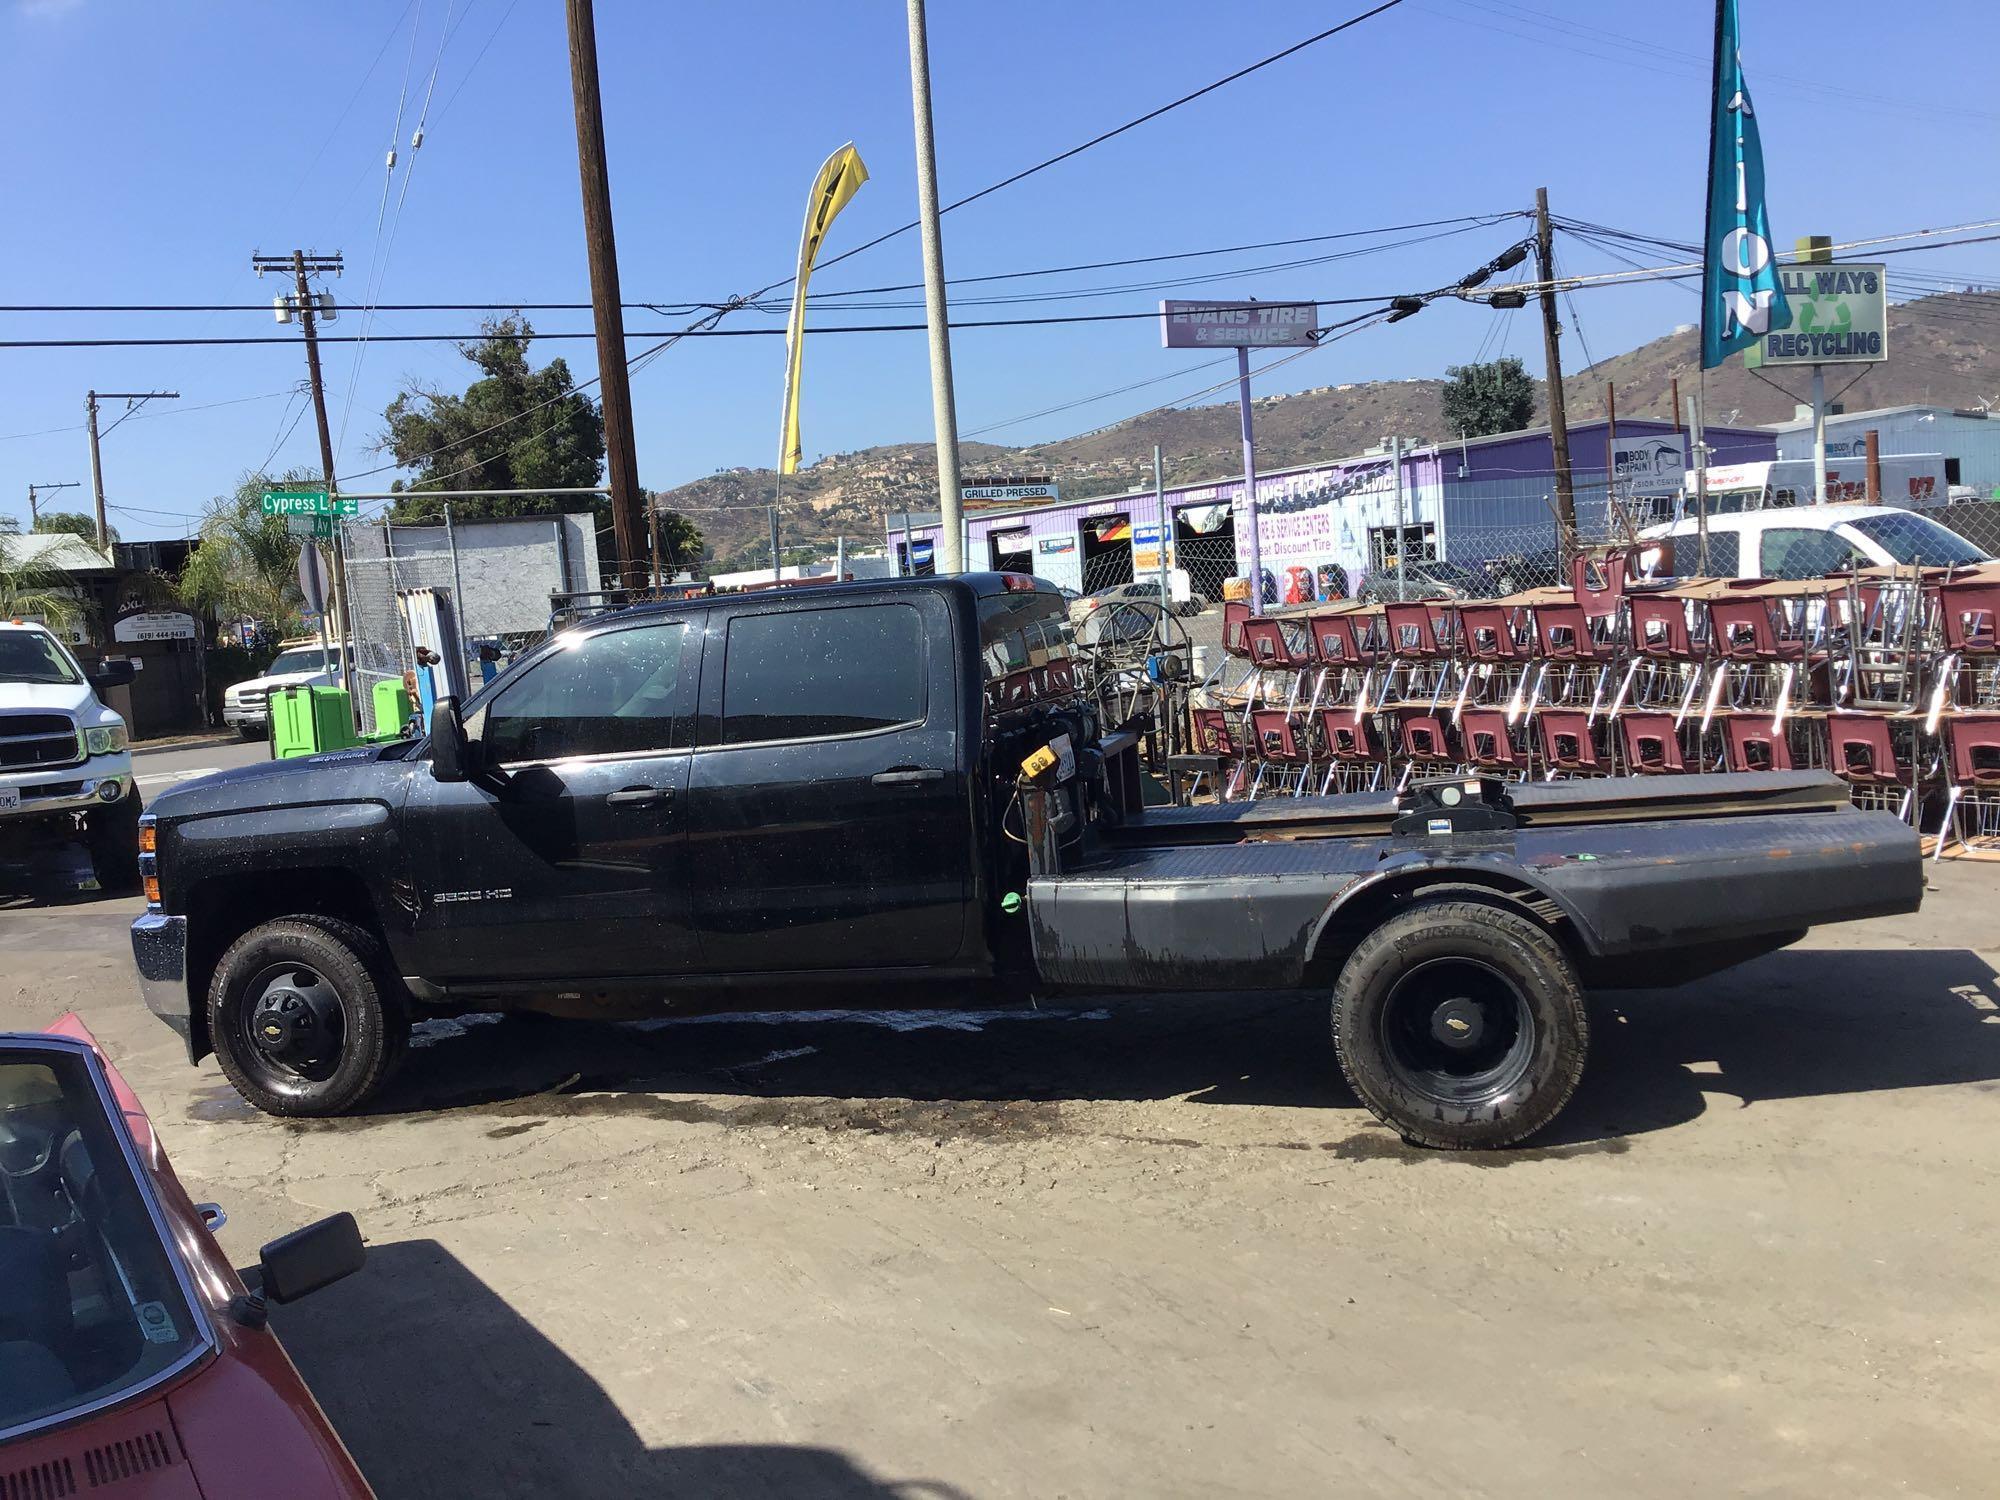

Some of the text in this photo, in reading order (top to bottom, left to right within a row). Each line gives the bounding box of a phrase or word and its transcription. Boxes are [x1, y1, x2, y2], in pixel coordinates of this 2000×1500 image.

[1782, 271, 1878, 295] LL WAYS
[1173, 306, 1310, 324] EVANS TIRE
[1196, 327, 1292, 341] & SERVICE
[1767, 331, 1881, 357] RECYCLING
[1629, 450, 1649, 461] BODY
[263, 494, 316, 514] Cypress
[1232, 484, 1284, 510] EANS
[1274, 538, 1311, 556] Discount
[1313, 536, 1332, 552] Tire
